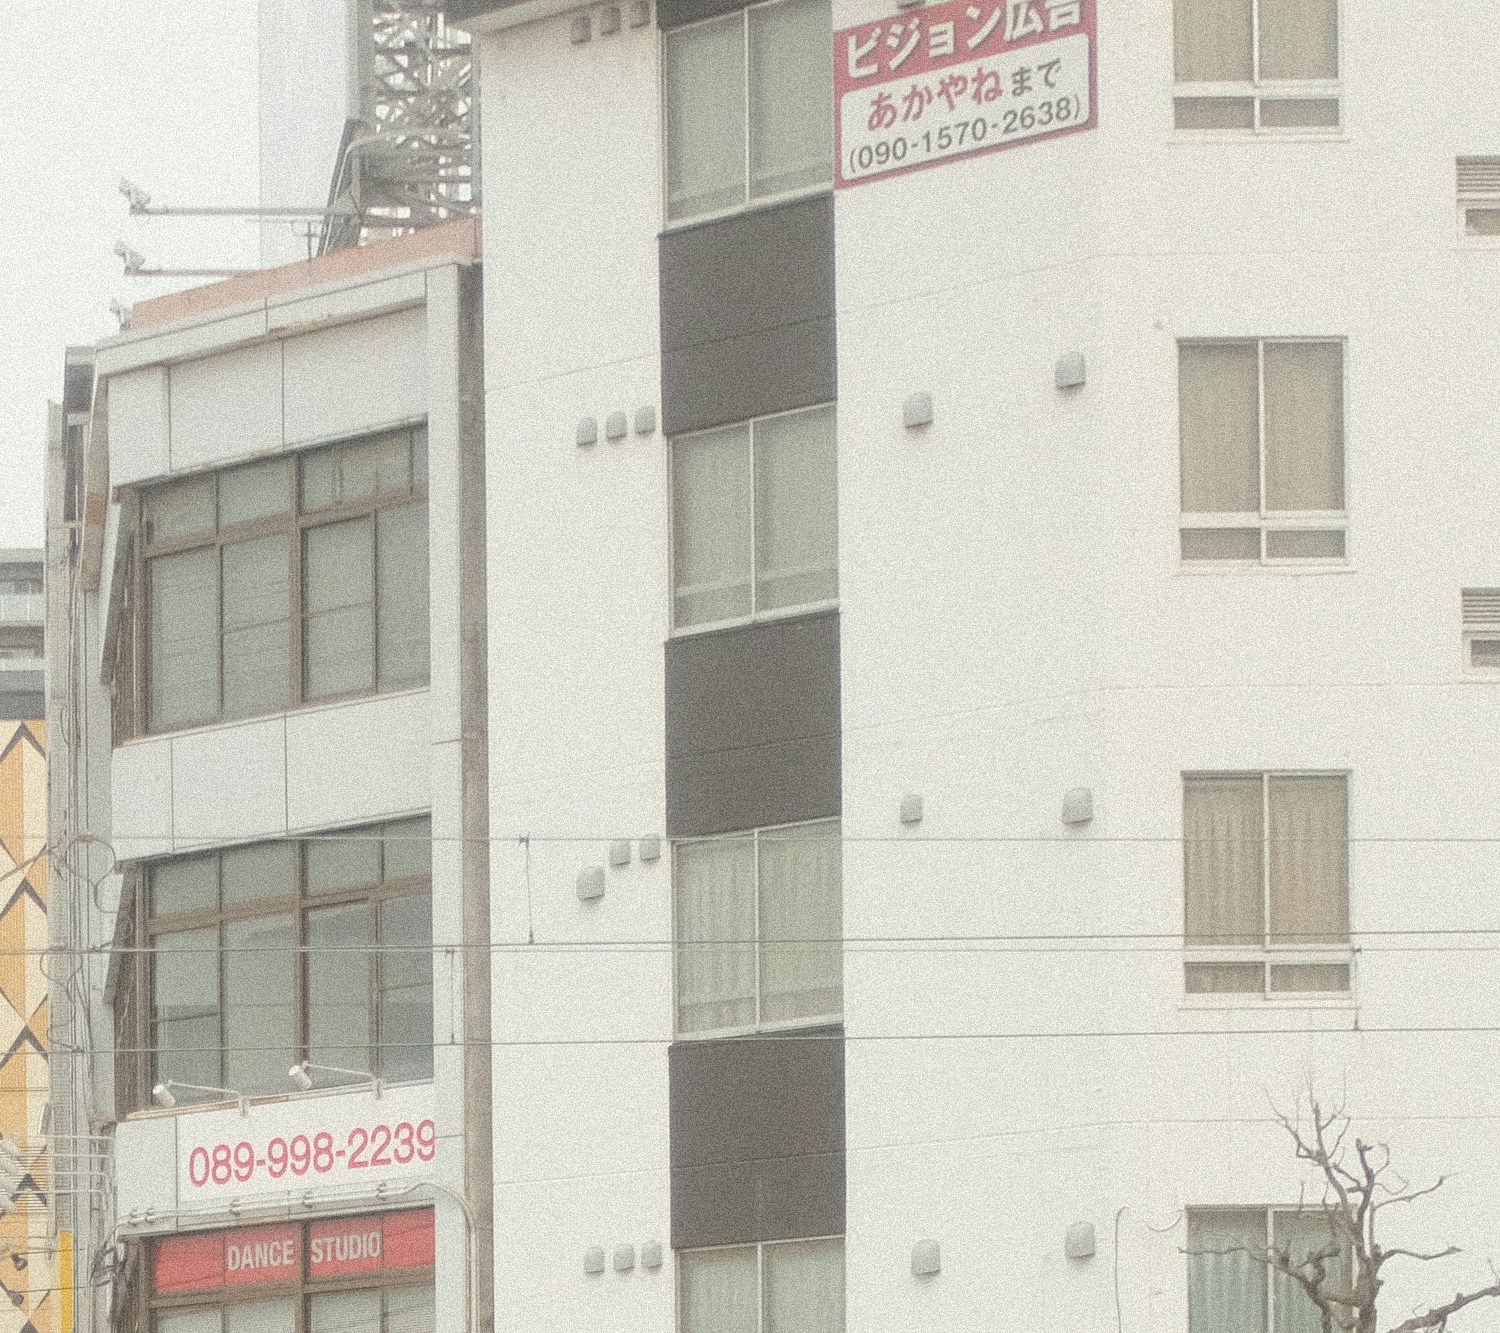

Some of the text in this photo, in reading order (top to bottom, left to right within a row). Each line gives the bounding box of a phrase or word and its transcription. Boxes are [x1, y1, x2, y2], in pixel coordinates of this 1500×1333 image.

[867, 57, 1063, 131] あかやねまで
[849, 94, 1082, 174] (090-1570-2638)
[189, 1119, 436, 1187] 089-998-2239
[226, 1231, 382, 1271] DANCE STUDIO
